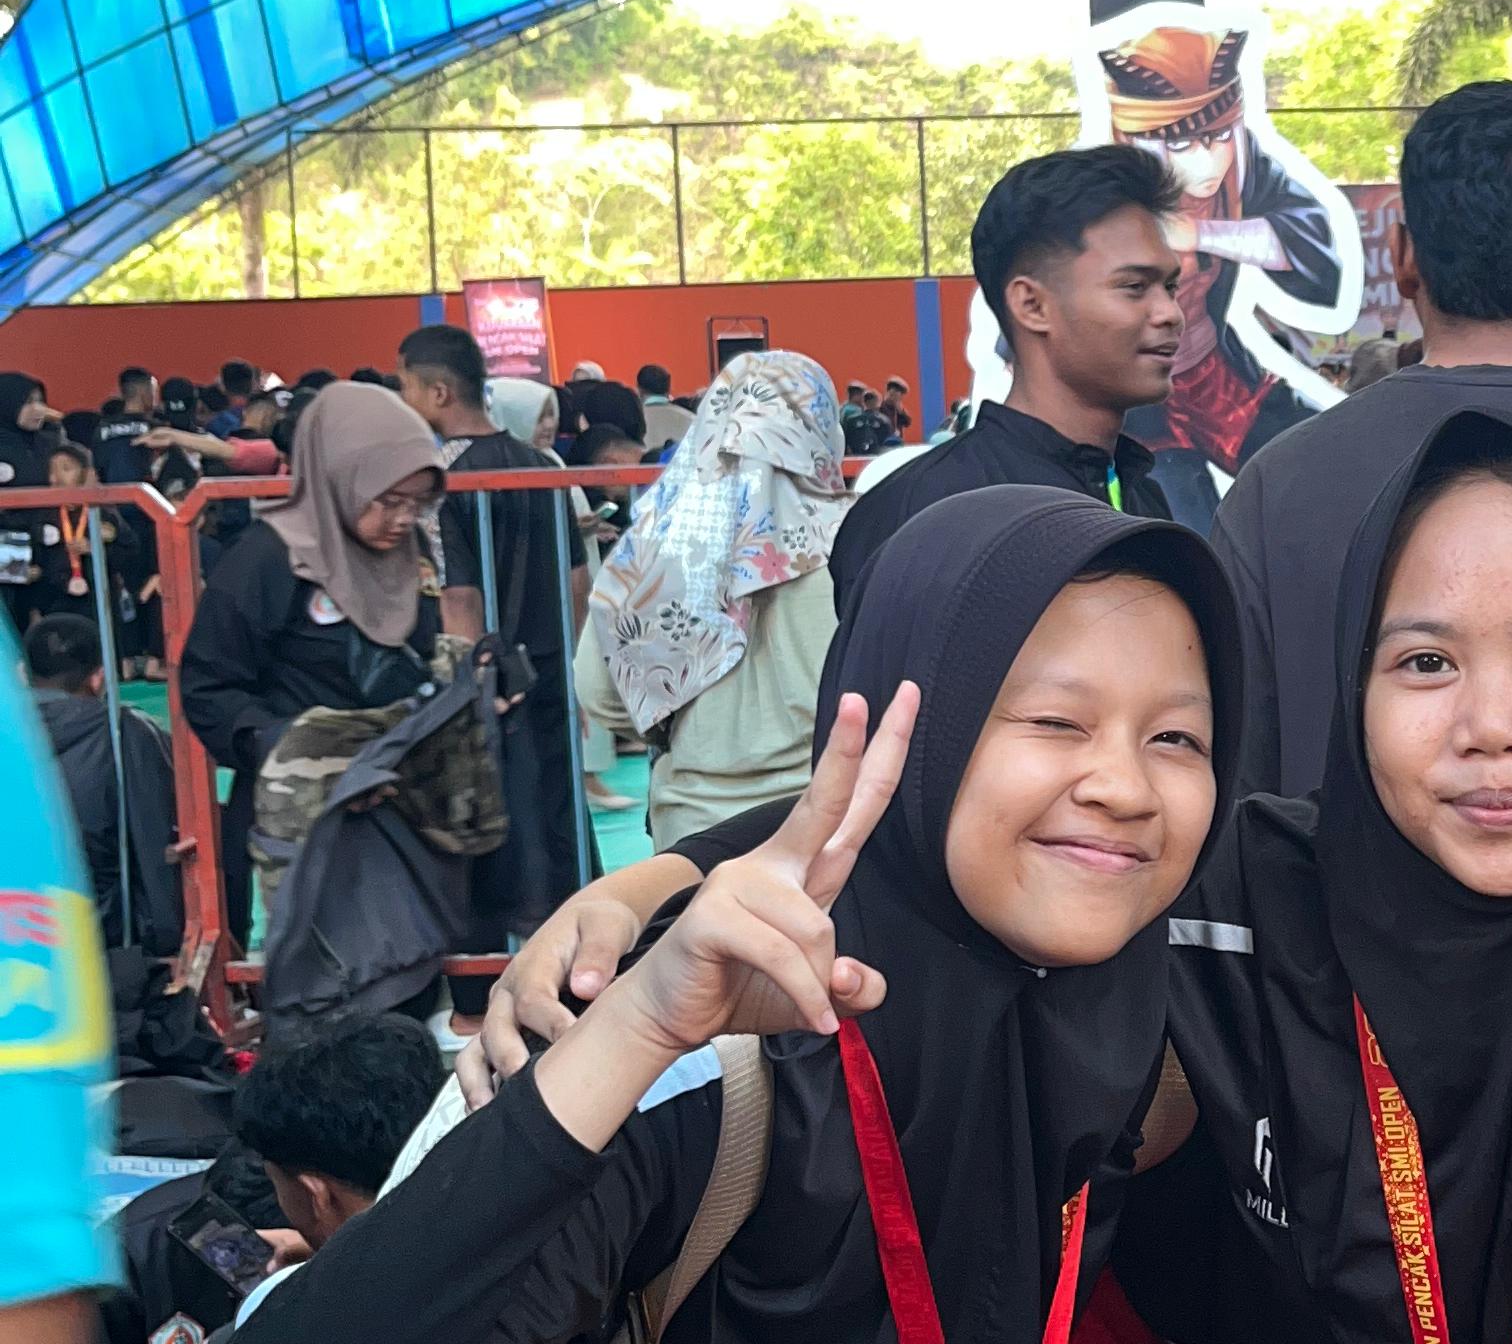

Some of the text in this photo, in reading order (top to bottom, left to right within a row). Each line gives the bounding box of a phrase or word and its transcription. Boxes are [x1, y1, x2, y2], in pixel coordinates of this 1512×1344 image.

[1378, 1085, 1405, 1138] OPEN
[1390, 1144, 1414, 1183] SMI
[1396, 1190, 1423, 1252] SILAT
[1408, 1246, 1438, 1331] PENCAK
